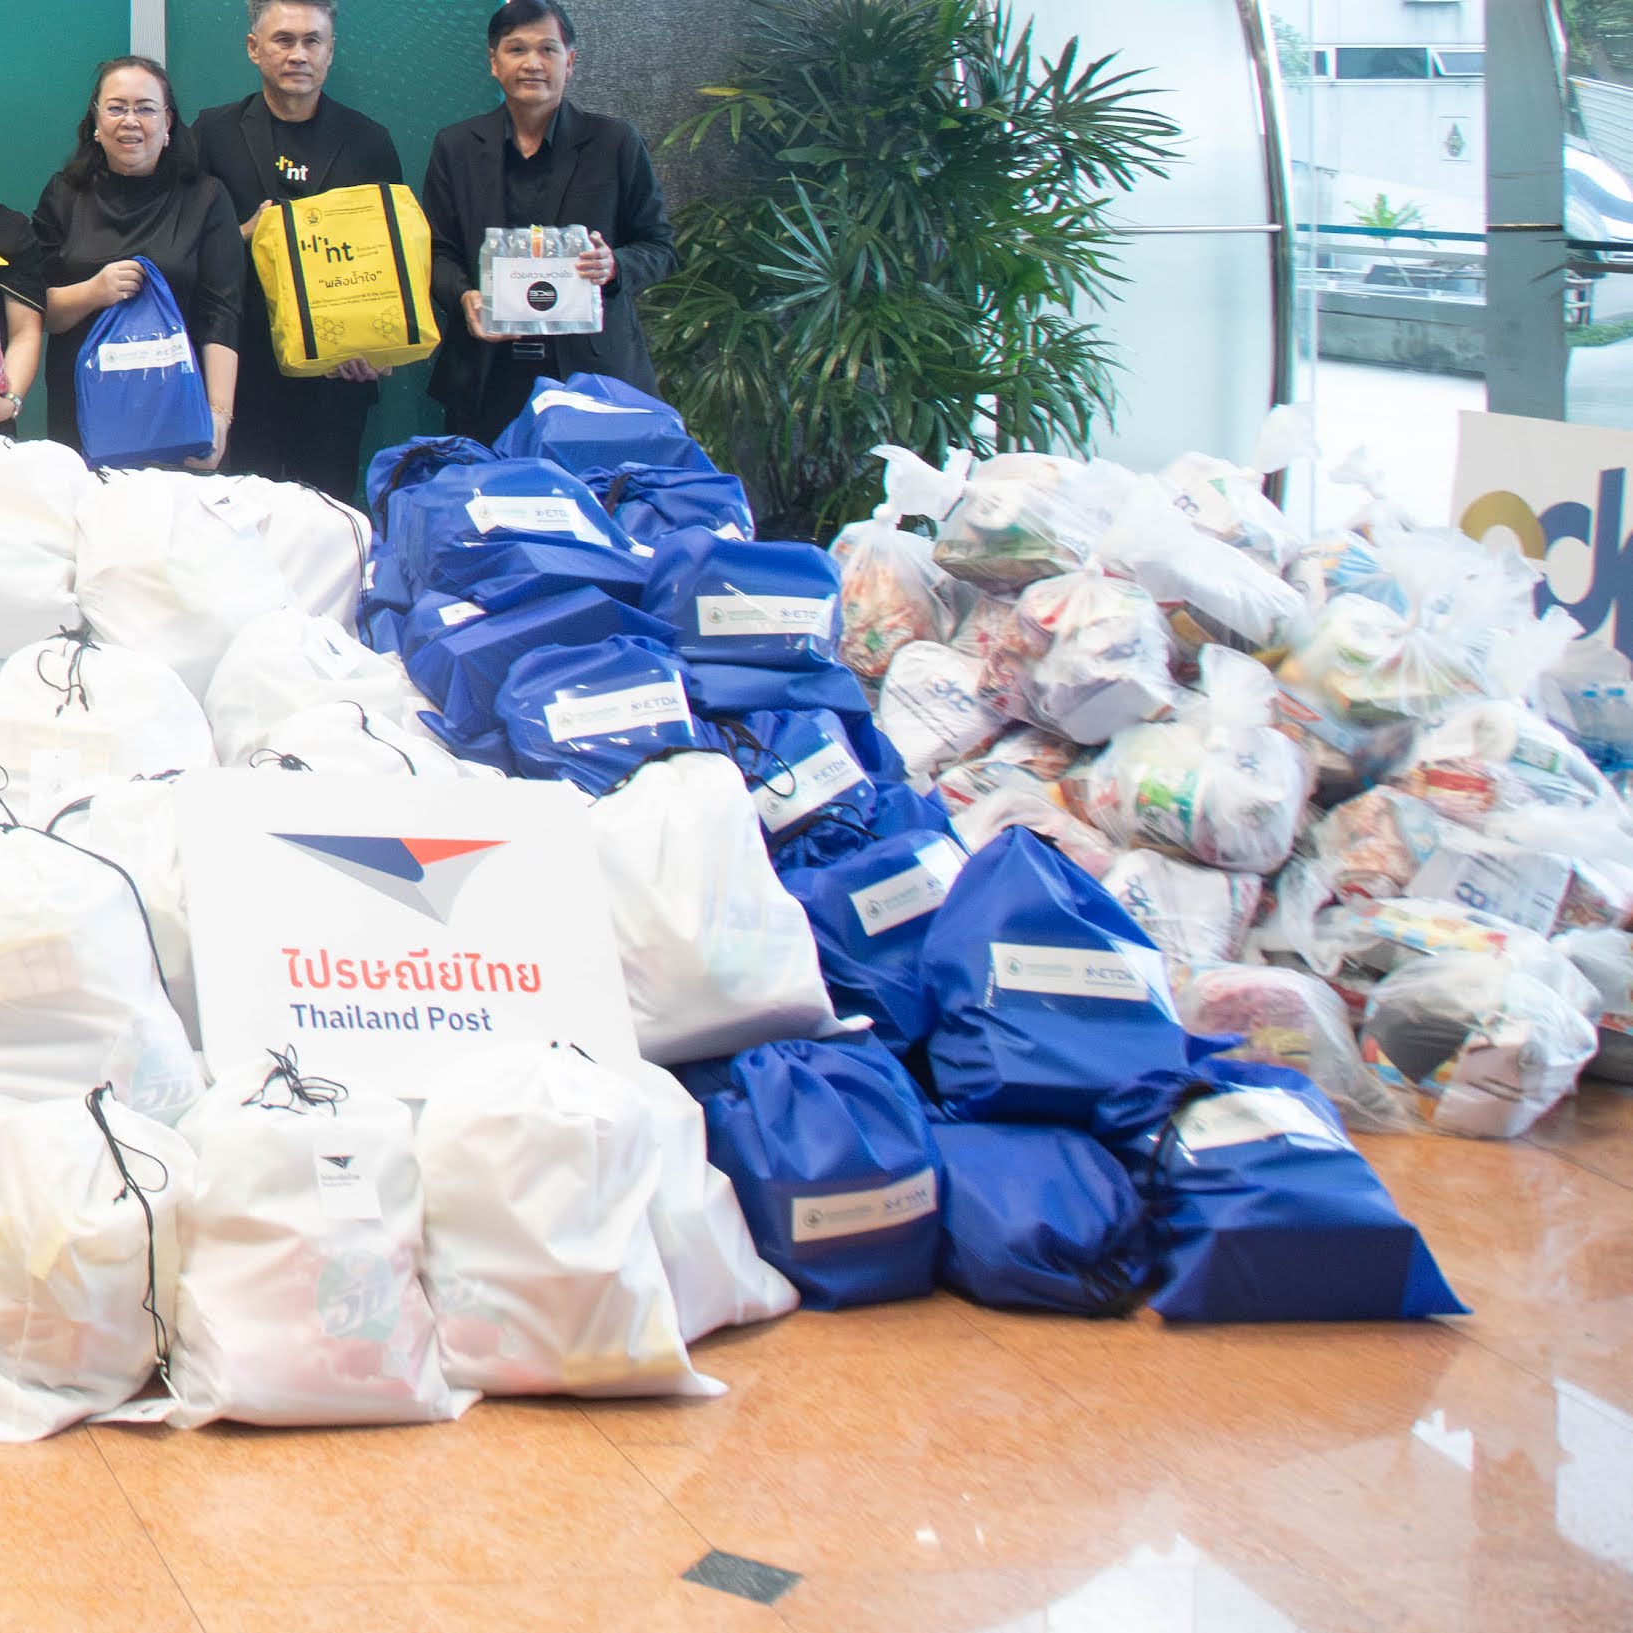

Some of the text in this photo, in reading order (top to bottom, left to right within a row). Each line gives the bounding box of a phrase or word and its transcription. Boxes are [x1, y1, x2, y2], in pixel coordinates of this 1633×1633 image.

[287, 165, 308, 181] nt
[327, 242, 354, 263] nt
[282, 946, 542, 995] ไปรษณีย์ไทย
[291, 1003, 493, 1032] Thailand Post
